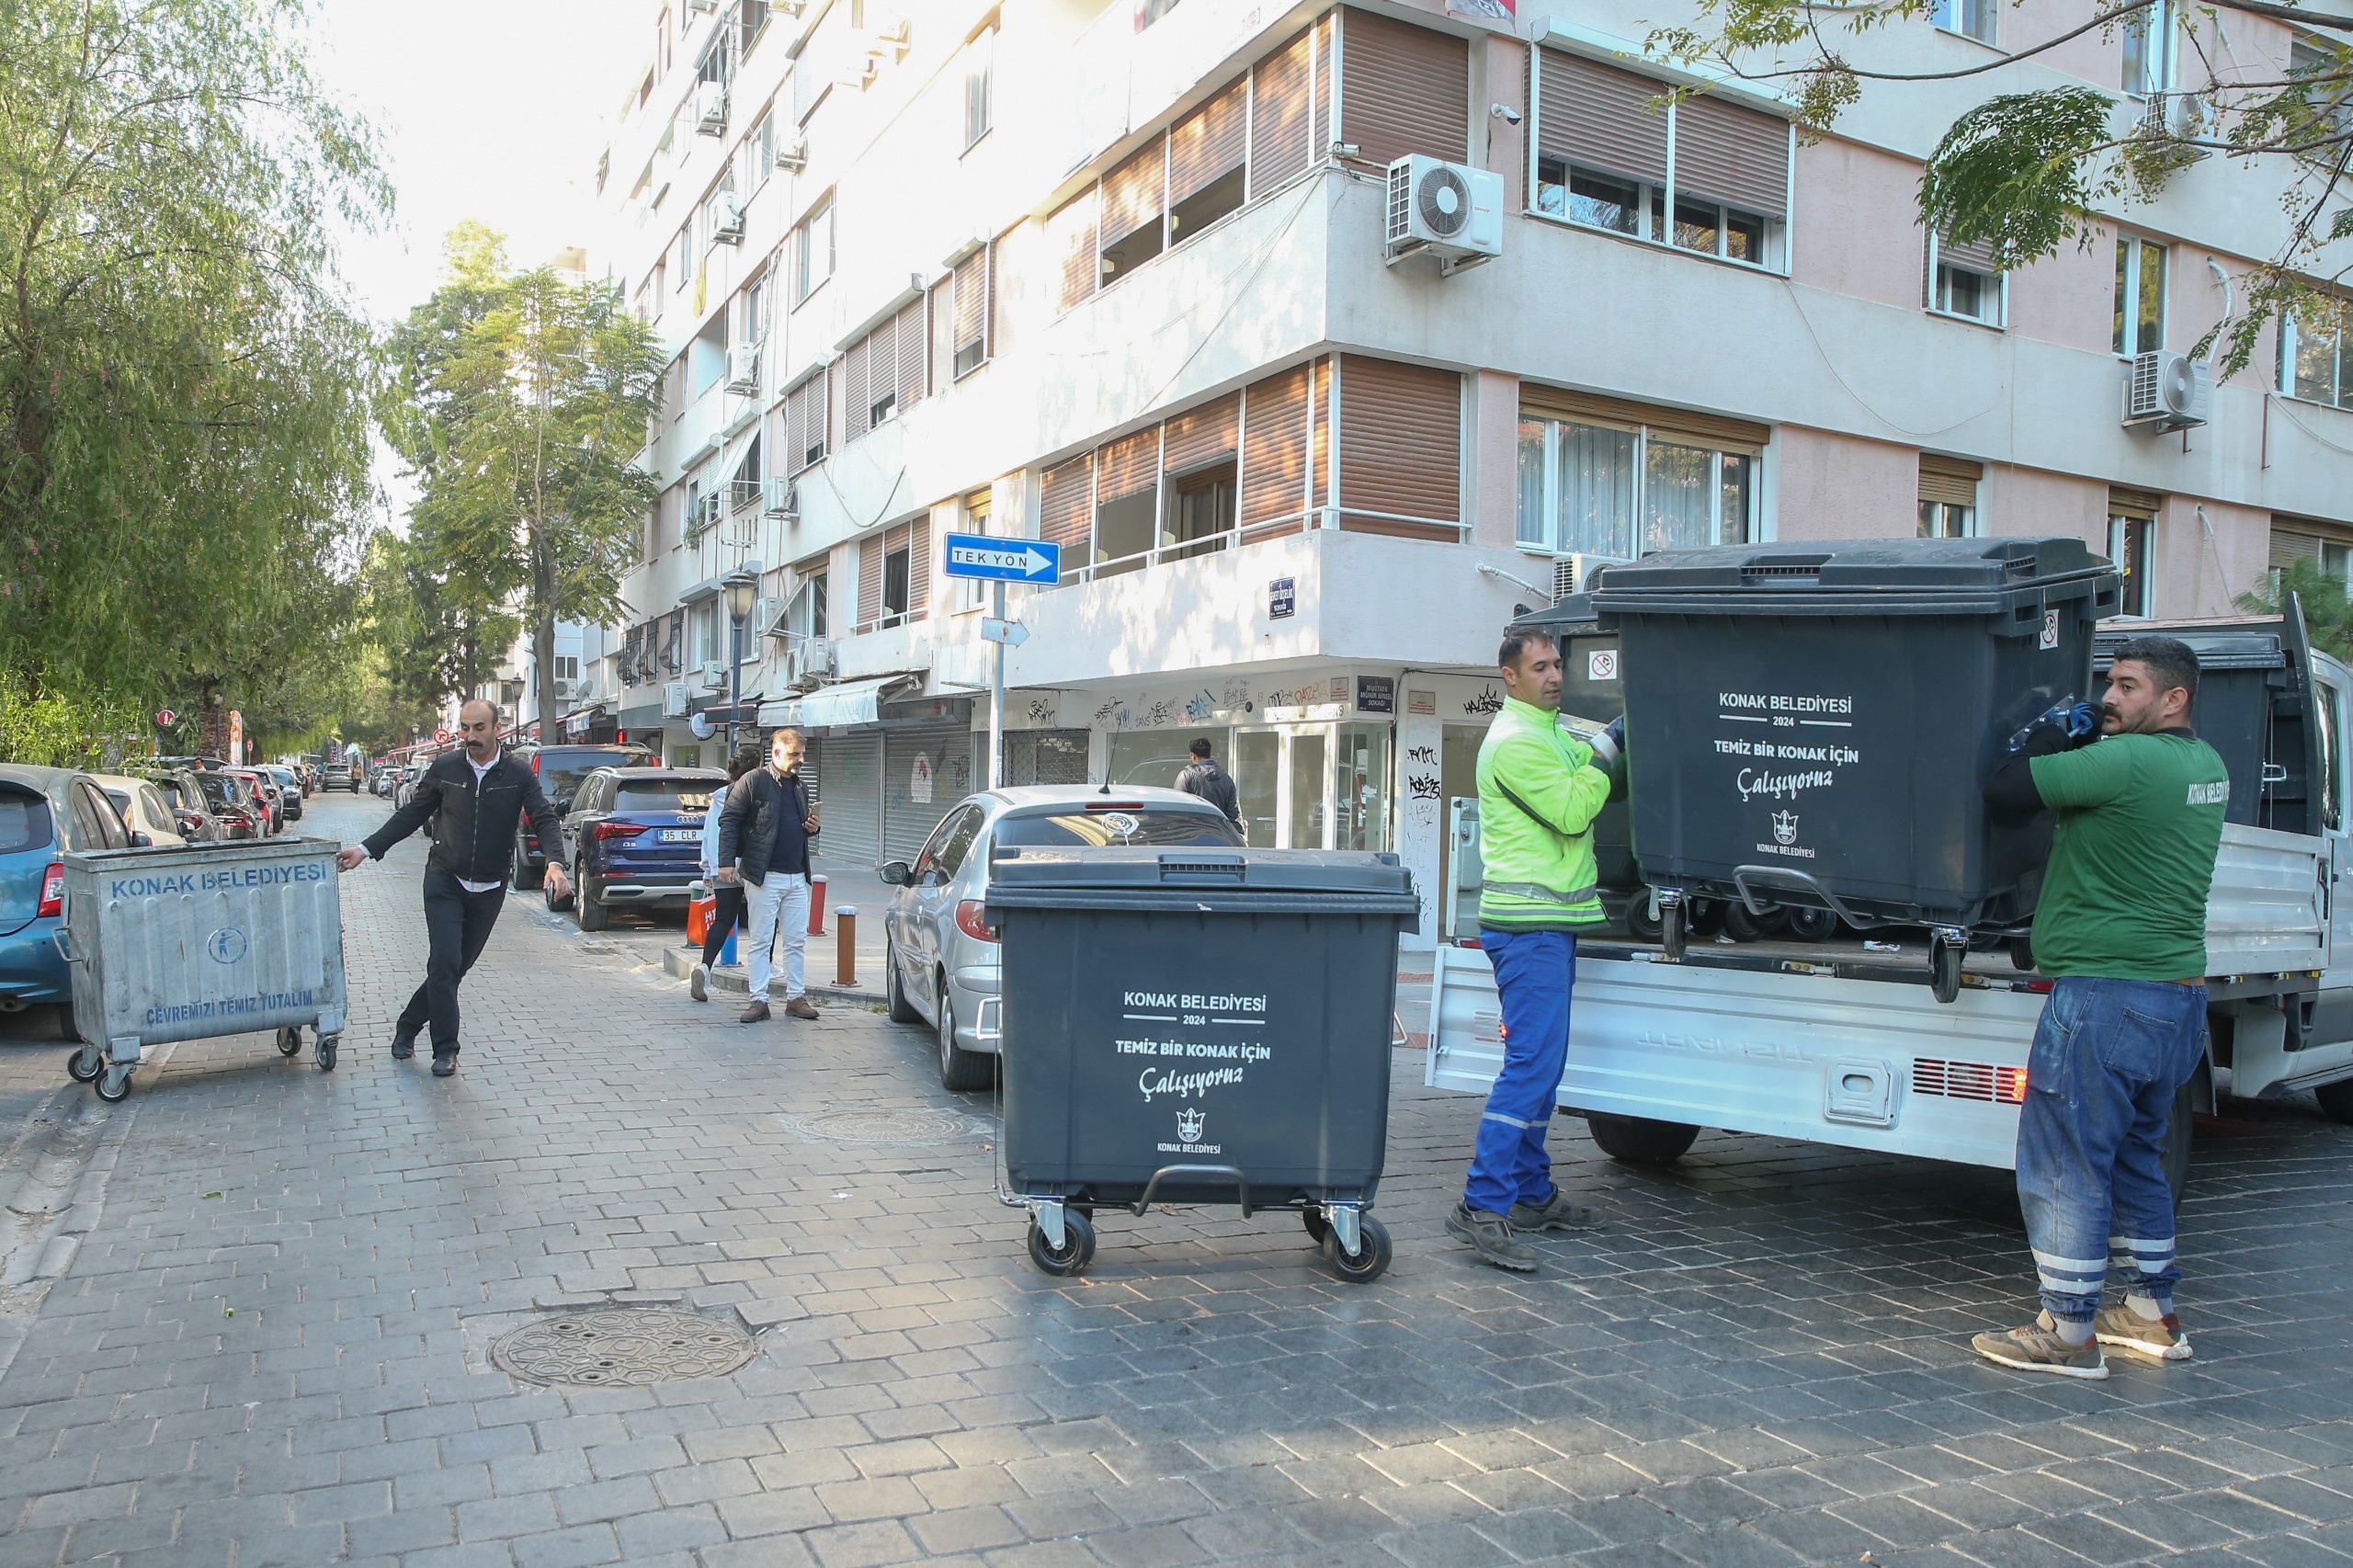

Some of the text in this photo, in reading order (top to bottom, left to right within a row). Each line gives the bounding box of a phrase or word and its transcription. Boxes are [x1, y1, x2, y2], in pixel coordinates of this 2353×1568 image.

[954, 551, 1028, 567] TEK YÖN
[1360, 690, 1392, 700] MÜNİR BİRSEL
[1719, 692, 1852, 714] KONAK BELEDİYESİ
[1772, 716, 1794, 727] 2024
[1714, 738, 1859, 767] TEMİZ BİR KONAK İÇİN
[1736, 767, 1833, 802] Çalışıyoruz
[665, 831, 697, 841] 35 CLR
[1756, 843, 1815, 858] KONAK BELEDİYESİ
[111, 860, 326, 898] KONAK BELEDİYESİ
[147, 990, 313, 1028] ÇEVREMİZİ TEMİZ TUTALIM
[1124, 991, 1267, 1012] KONAK BELEDİYESİ
[1182, 1015, 1206, 1026] 2024
[1115, 1038, 1271, 1063] TEMİZ BİR KONAK İÇİN
[1139, 1067, 1244, 1103] Çalışıyoruz
[1157, 1142, 1221, 1154] KONAK BELEDİYESİ
